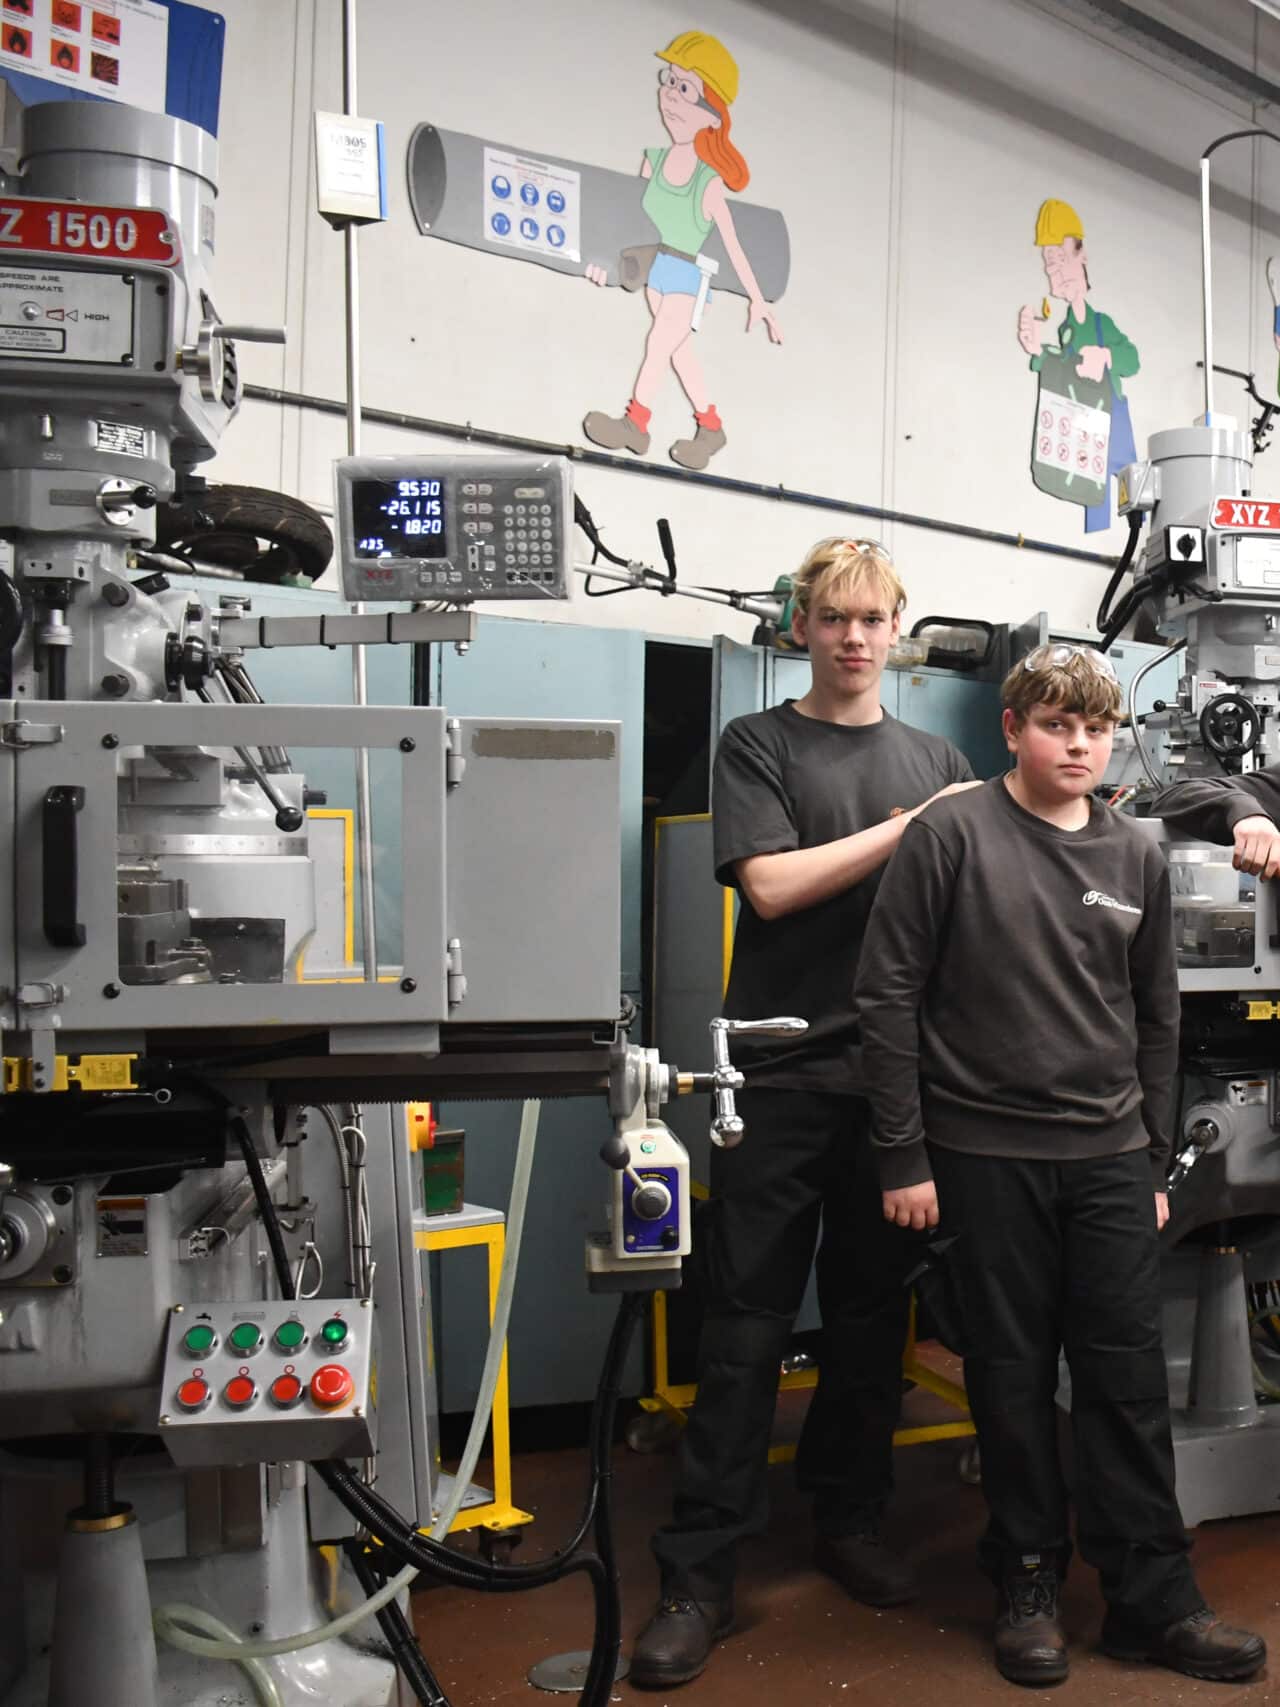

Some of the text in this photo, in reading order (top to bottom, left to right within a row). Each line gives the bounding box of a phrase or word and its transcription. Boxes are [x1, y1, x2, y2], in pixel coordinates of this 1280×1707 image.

[48, 211, 138, 251] 1500
[84, 313, 110, 321] HIGH
[1231, 503, 1270, 526] XYZ
